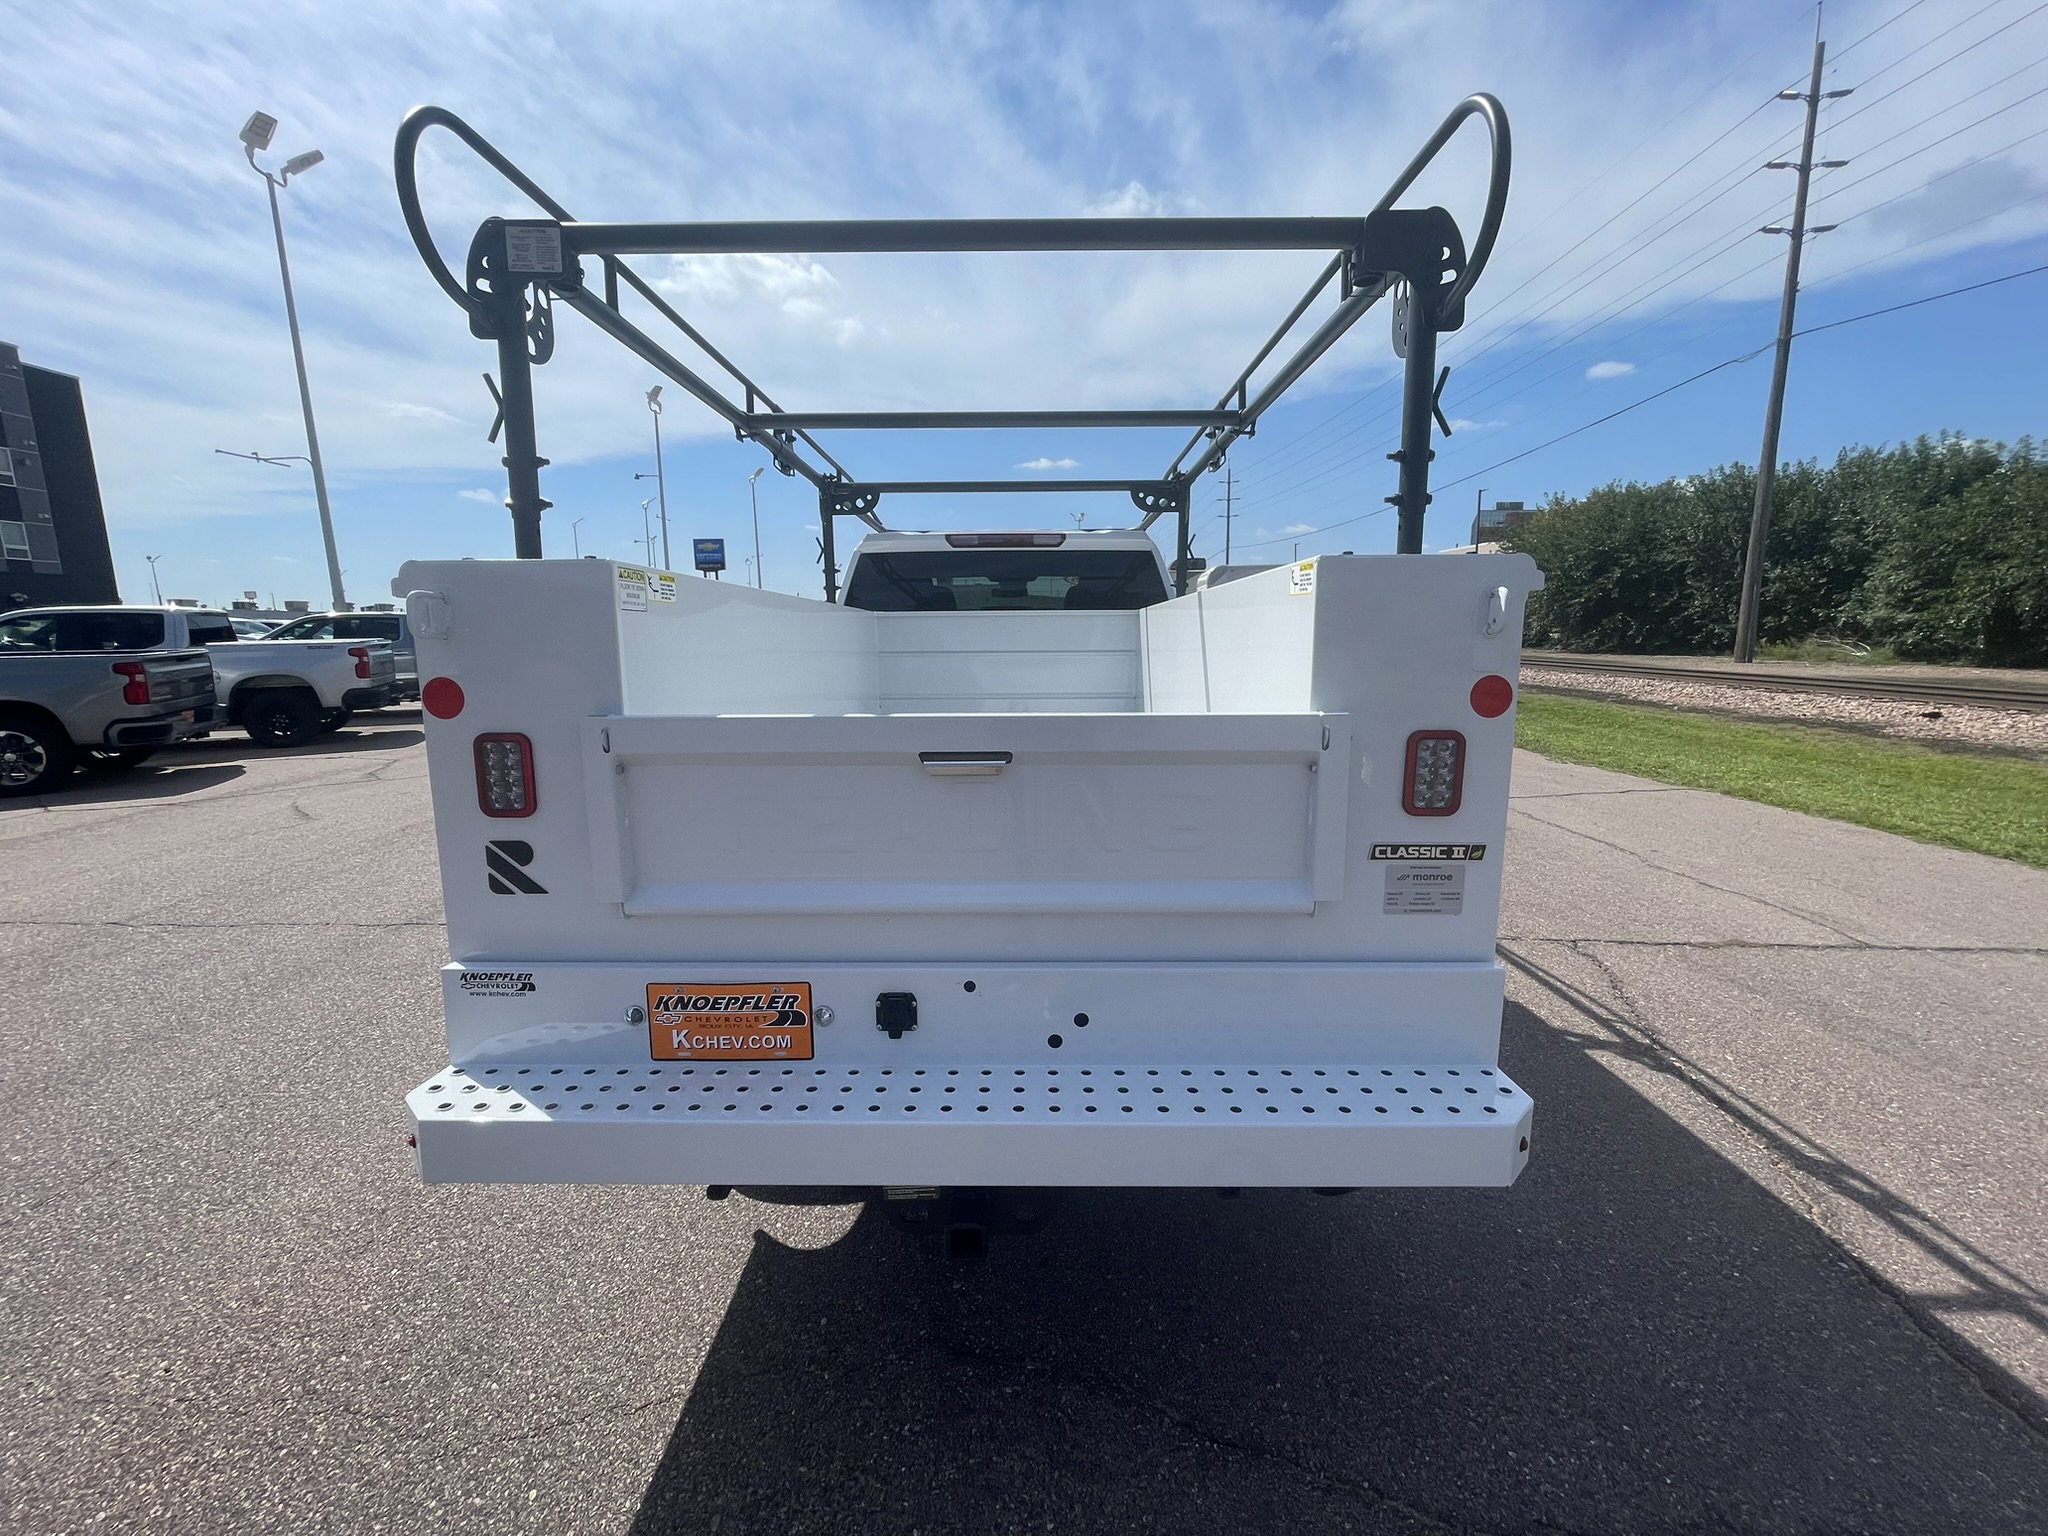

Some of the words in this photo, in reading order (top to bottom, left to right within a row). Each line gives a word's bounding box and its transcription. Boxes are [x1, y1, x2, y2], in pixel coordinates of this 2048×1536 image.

[623, 570, 645, 581] CAUTION
[1374, 846, 1448, 858] CLASSIC
[1451, 846, 1466, 858] II
[1412, 873, 1453, 881] monroe
[460, 972, 533, 982] KNOEPFLER
[654, 994, 801, 1011] KNOEPFLER
